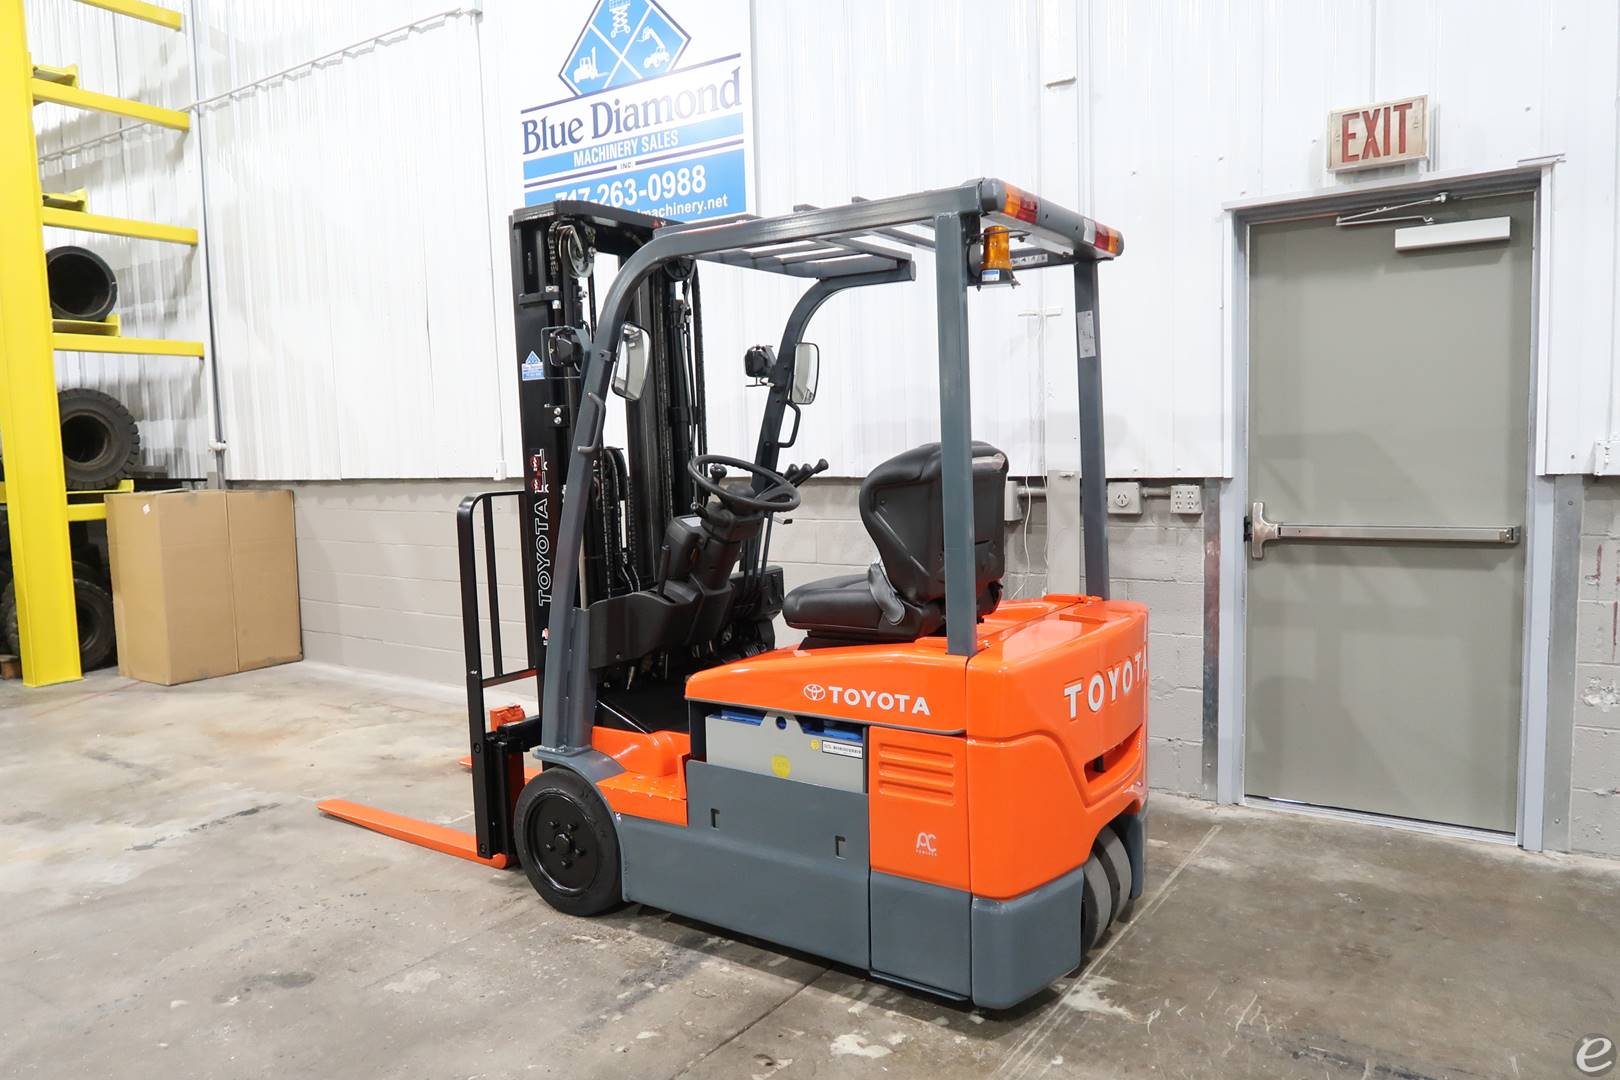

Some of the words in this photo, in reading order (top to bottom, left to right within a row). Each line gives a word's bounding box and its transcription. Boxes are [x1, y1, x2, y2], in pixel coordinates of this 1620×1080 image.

[522, 116, 584, 155] Blue
[591, 66, 743, 140] Diamond
[573, 139, 639, 168] MACHINERY
[641, 129, 679, 153] SALES
[1341, 102, 1413, 163] EXIT
[636, 193, 729, 219] machinery.net
[534, 497, 553, 607] TOYOTA
[828, 685, 931, 716] TOYOTA
[916, 831, 937, 852] AC
